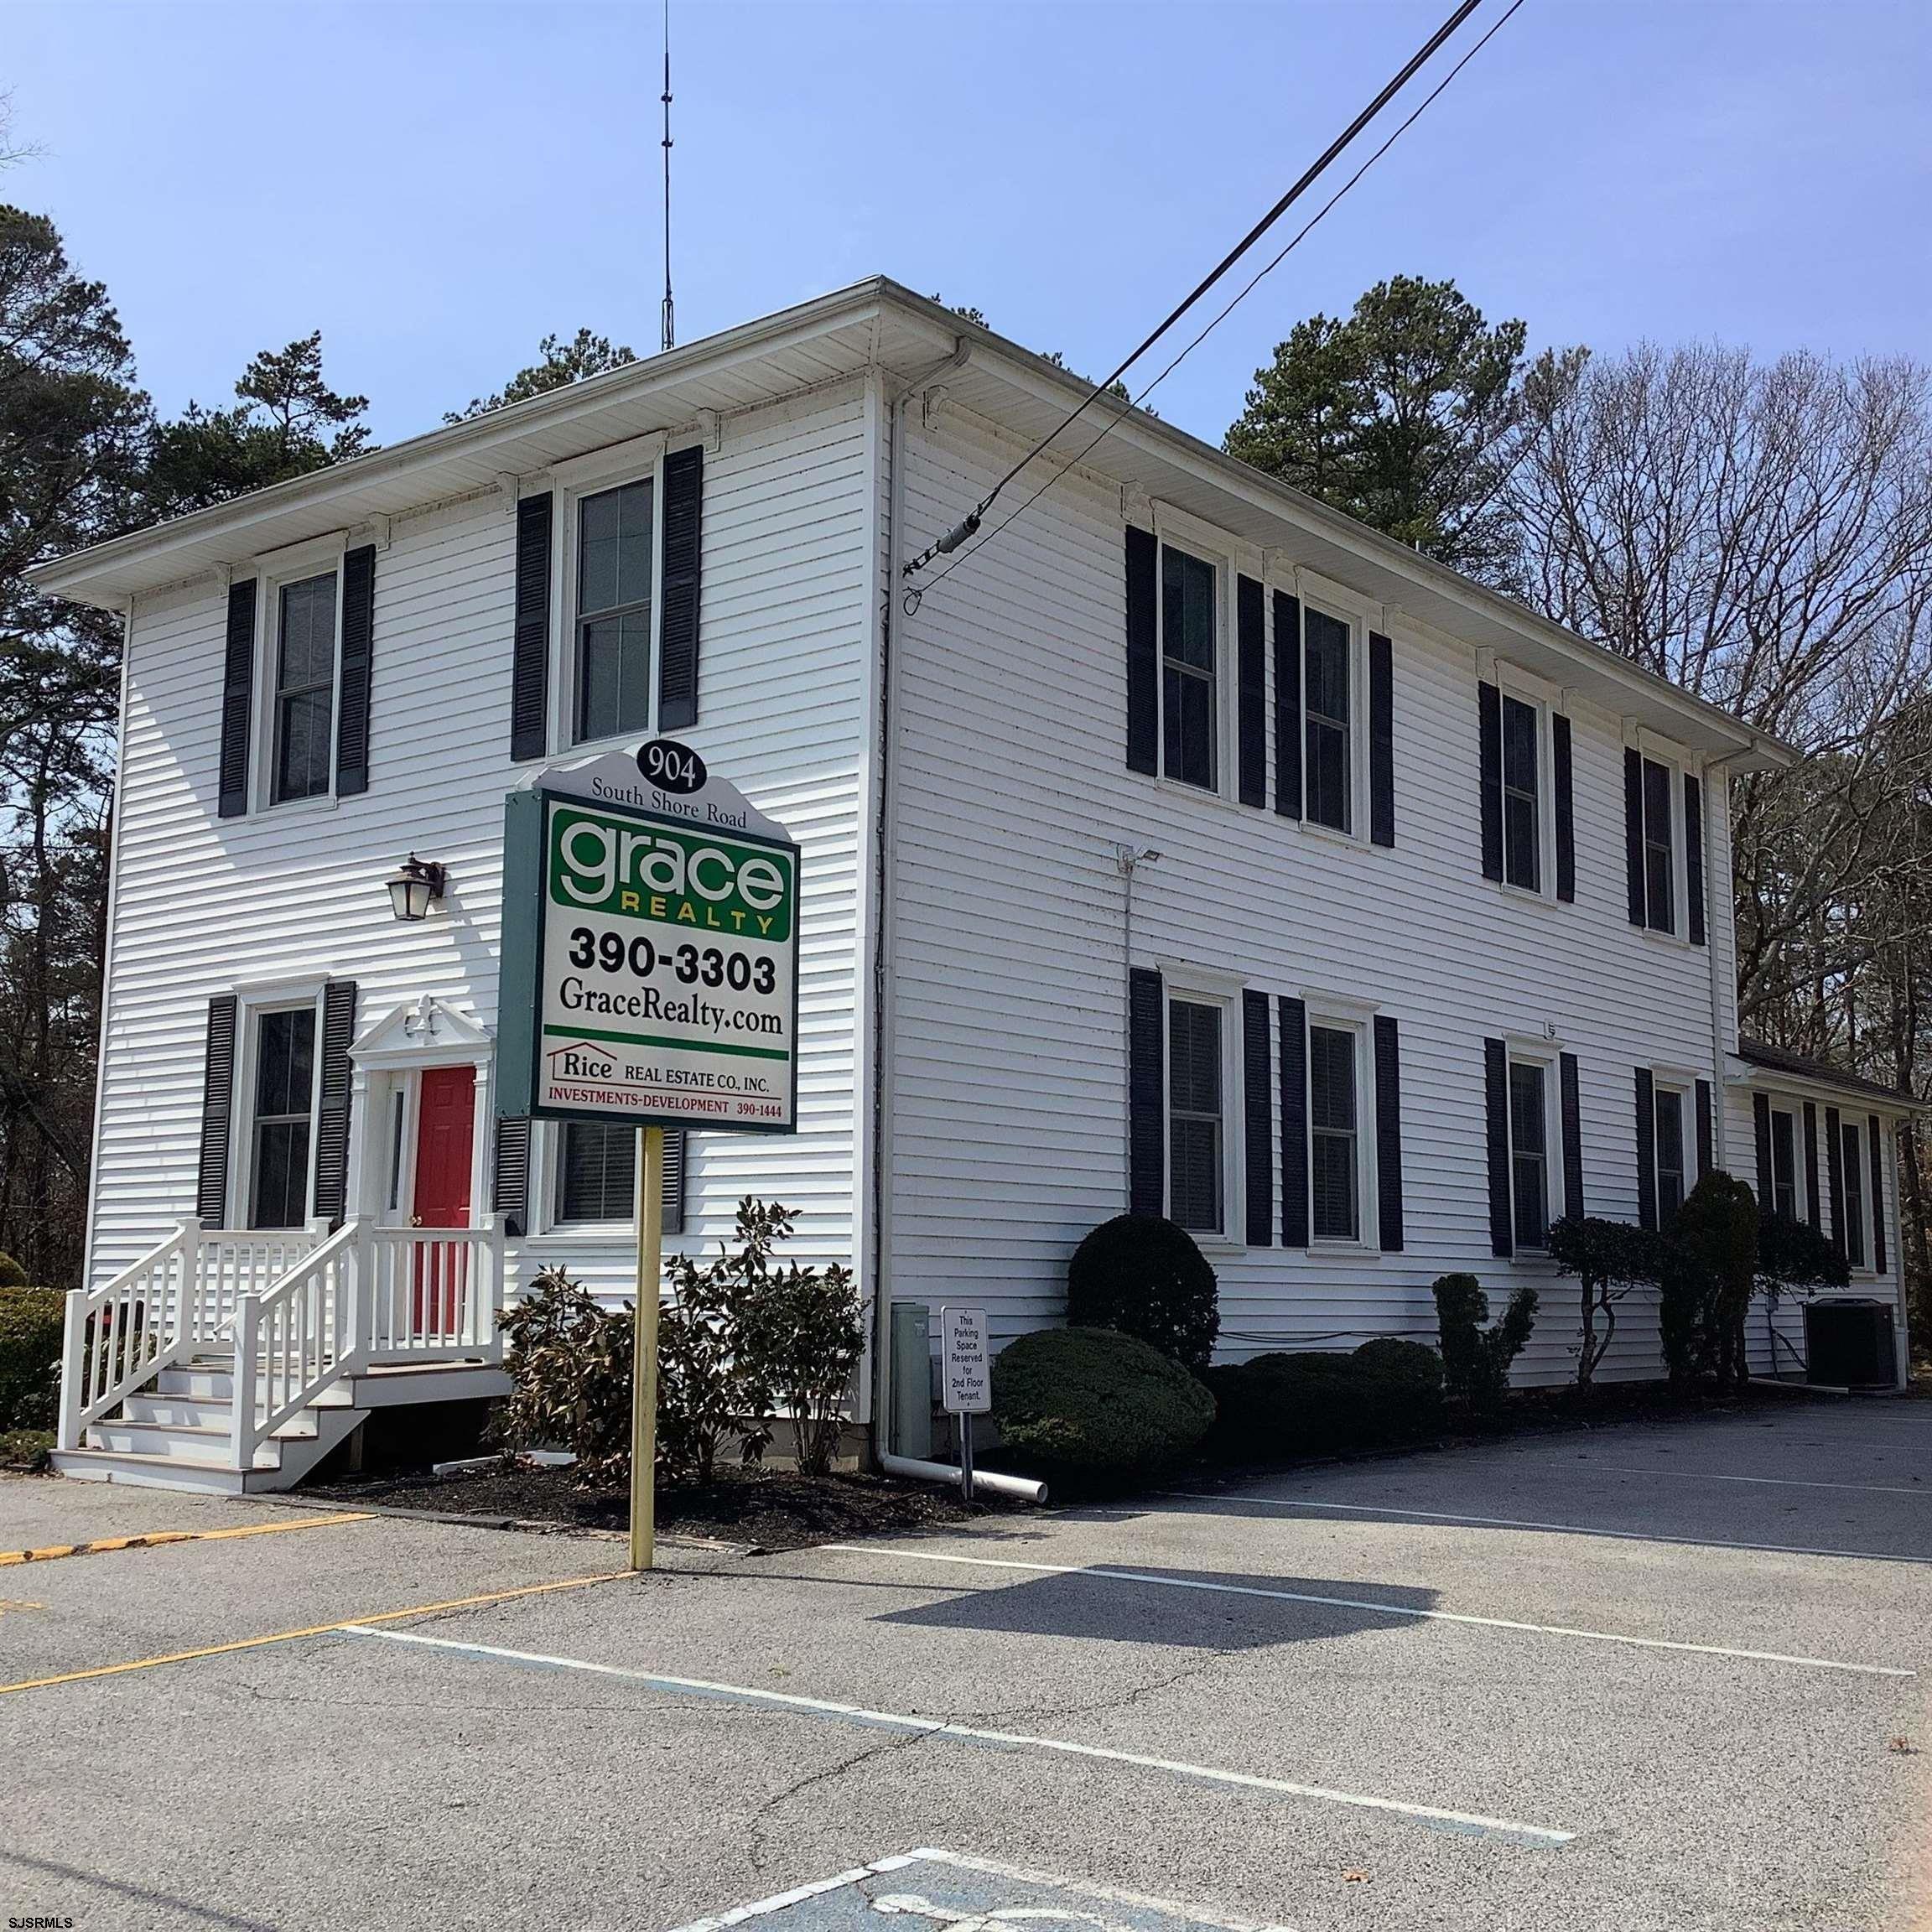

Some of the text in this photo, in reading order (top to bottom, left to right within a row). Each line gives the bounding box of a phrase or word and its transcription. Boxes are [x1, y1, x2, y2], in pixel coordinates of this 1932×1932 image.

[648, 746, 696, 787] 904
[591, 776, 747, 829] South Shore Road
[560, 821, 784, 910] grace
[621, 891, 773, 935] REALTY
[569, 927, 776, 995] 390-3303
[559, 977, 783, 1035] GraceRealty.com
[563, 1052, 770, 1093] Rice REAL ESTATE CO., INC.
[736, 1102, 782, 1118] 390-1444
[954, 1328, 979, 1340] Parking
[958, 1316, 974, 1325] This
[951, 1353, 983, 1363] Reserved
[956, 1341, 978, 1351] Space
[952, 1379, 984, 1388] 2nd Floor
[963, 1366, 973, 1375] for
